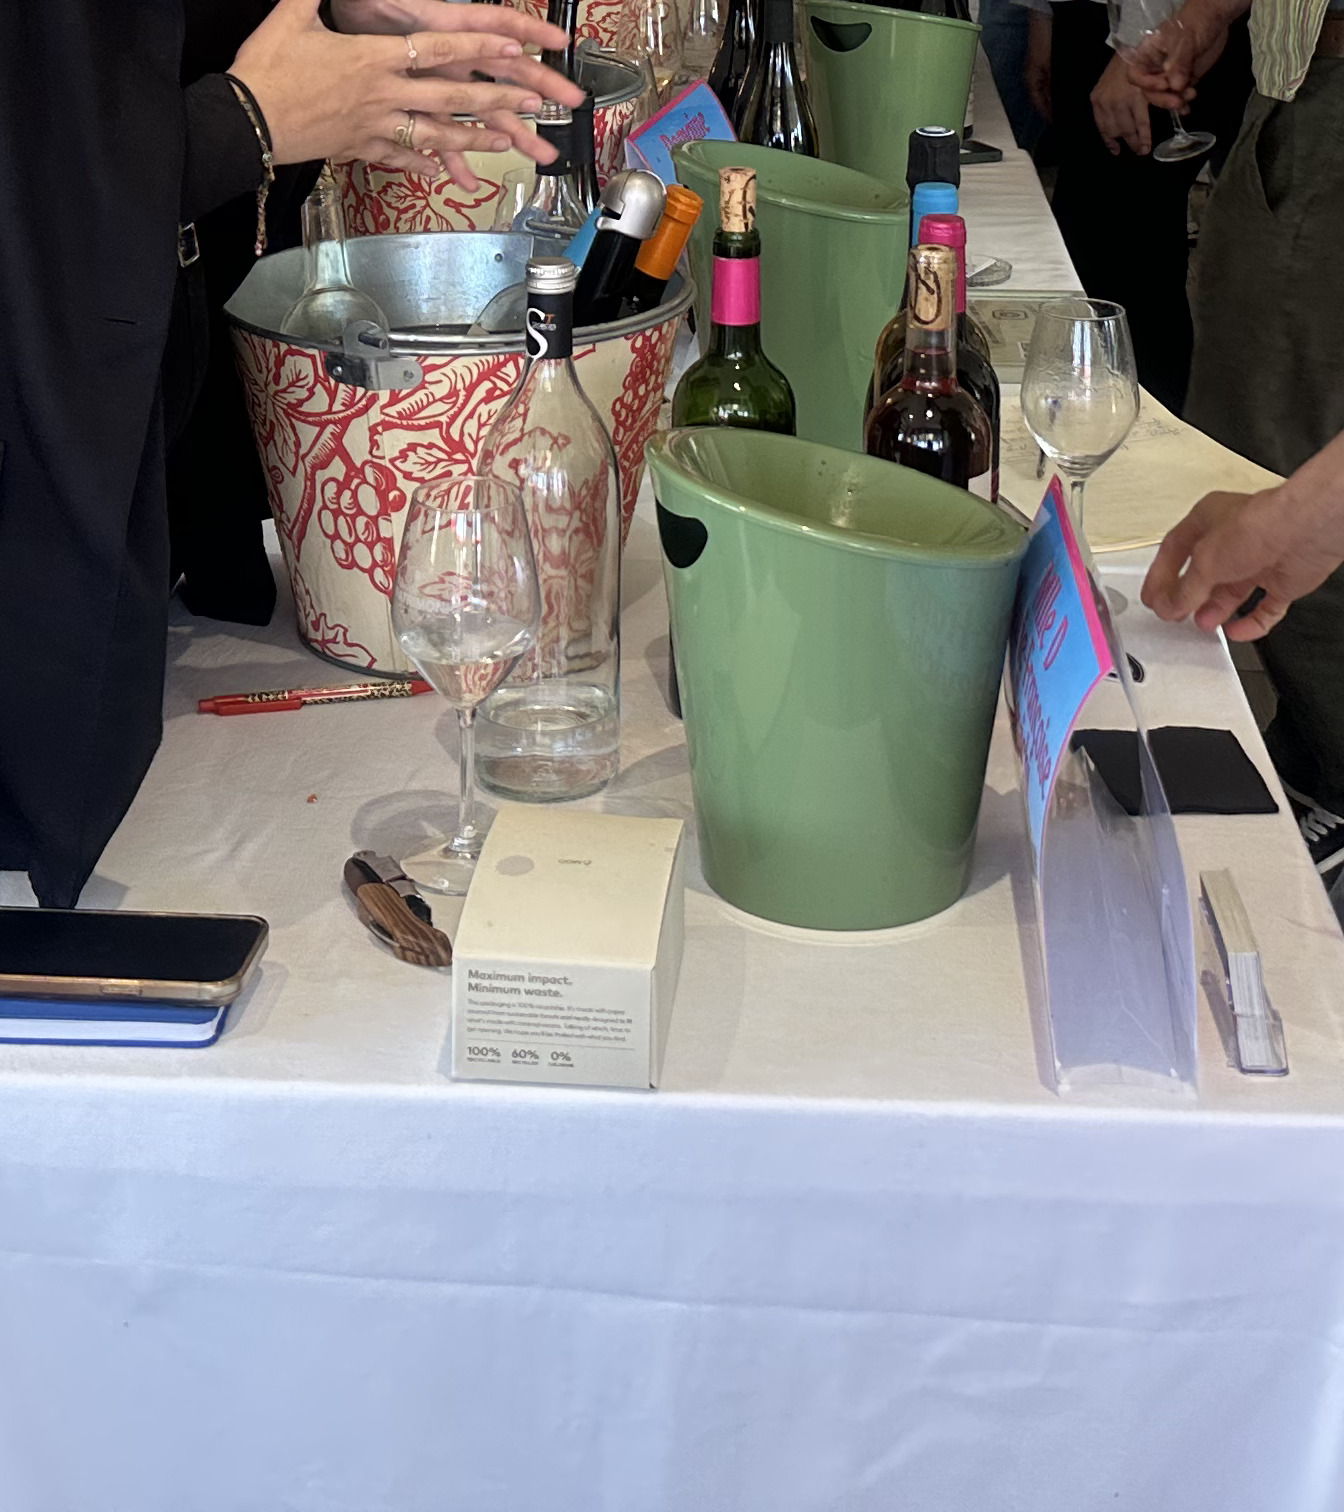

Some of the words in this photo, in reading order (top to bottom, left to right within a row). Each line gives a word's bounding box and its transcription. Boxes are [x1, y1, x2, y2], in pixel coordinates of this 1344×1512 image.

[467, 969, 525, 983] Maximum
[527, 972, 573, 986] impact.
[467, 982, 521, 996] Minimum
[524, 986, 564, 998] waste.
[467, 1046, 501, 1057] 100%
[511, 1048, 539, 1060] 60%
[550, 1051, 572, 1061] 0%
